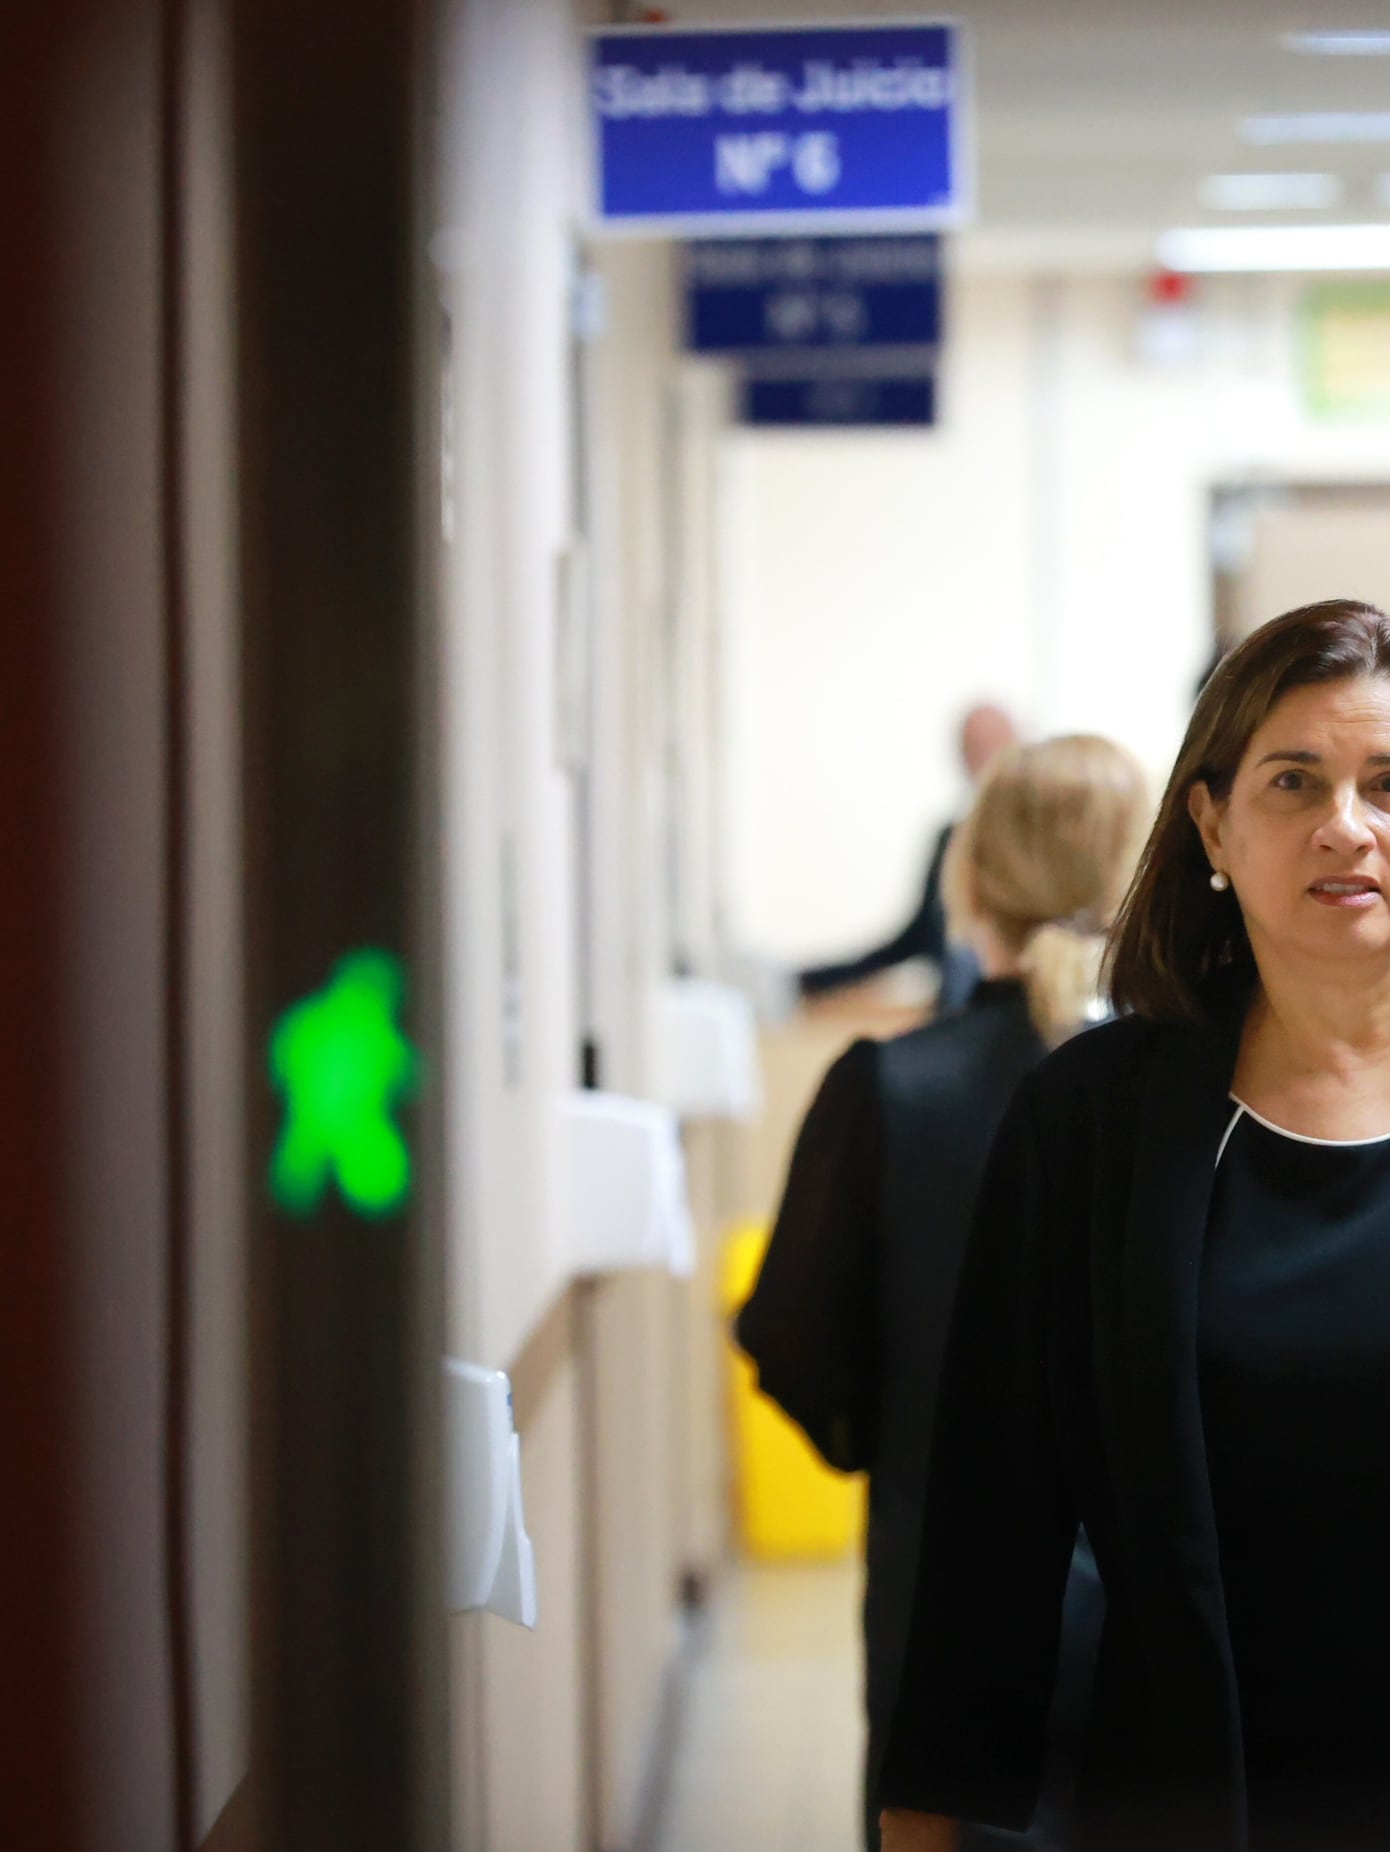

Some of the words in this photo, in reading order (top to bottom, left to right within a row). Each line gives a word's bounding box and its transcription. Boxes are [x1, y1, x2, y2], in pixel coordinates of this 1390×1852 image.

[598, 64, 709, 120] Sala
[716, 60, 789, 116] de
[795, 57, 947, 113] Juicio
[793, 131, 840, 195] 6
